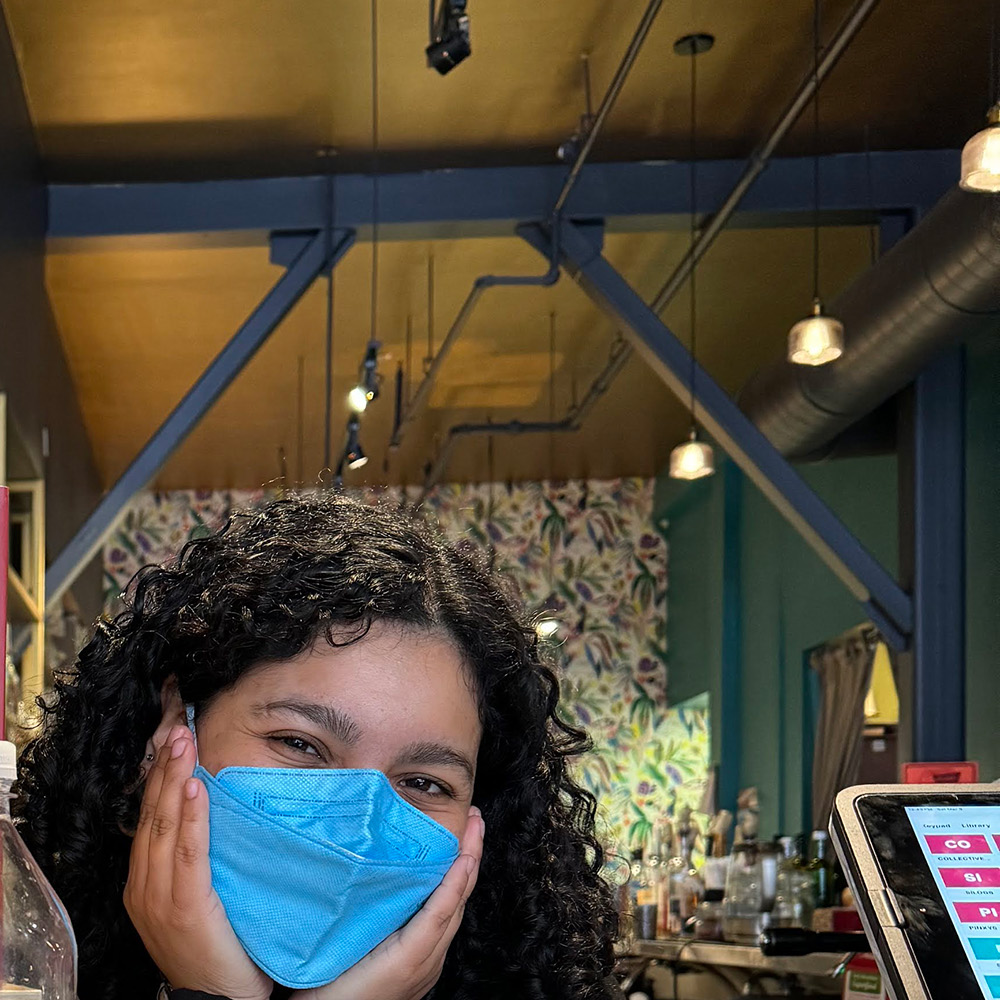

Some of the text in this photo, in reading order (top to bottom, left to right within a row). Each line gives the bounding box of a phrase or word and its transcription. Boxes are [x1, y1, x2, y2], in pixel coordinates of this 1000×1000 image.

[944, 839, 971, 849] CO
[963, 873, 983, 883] SI
[978, 907, 998, 917] PI
